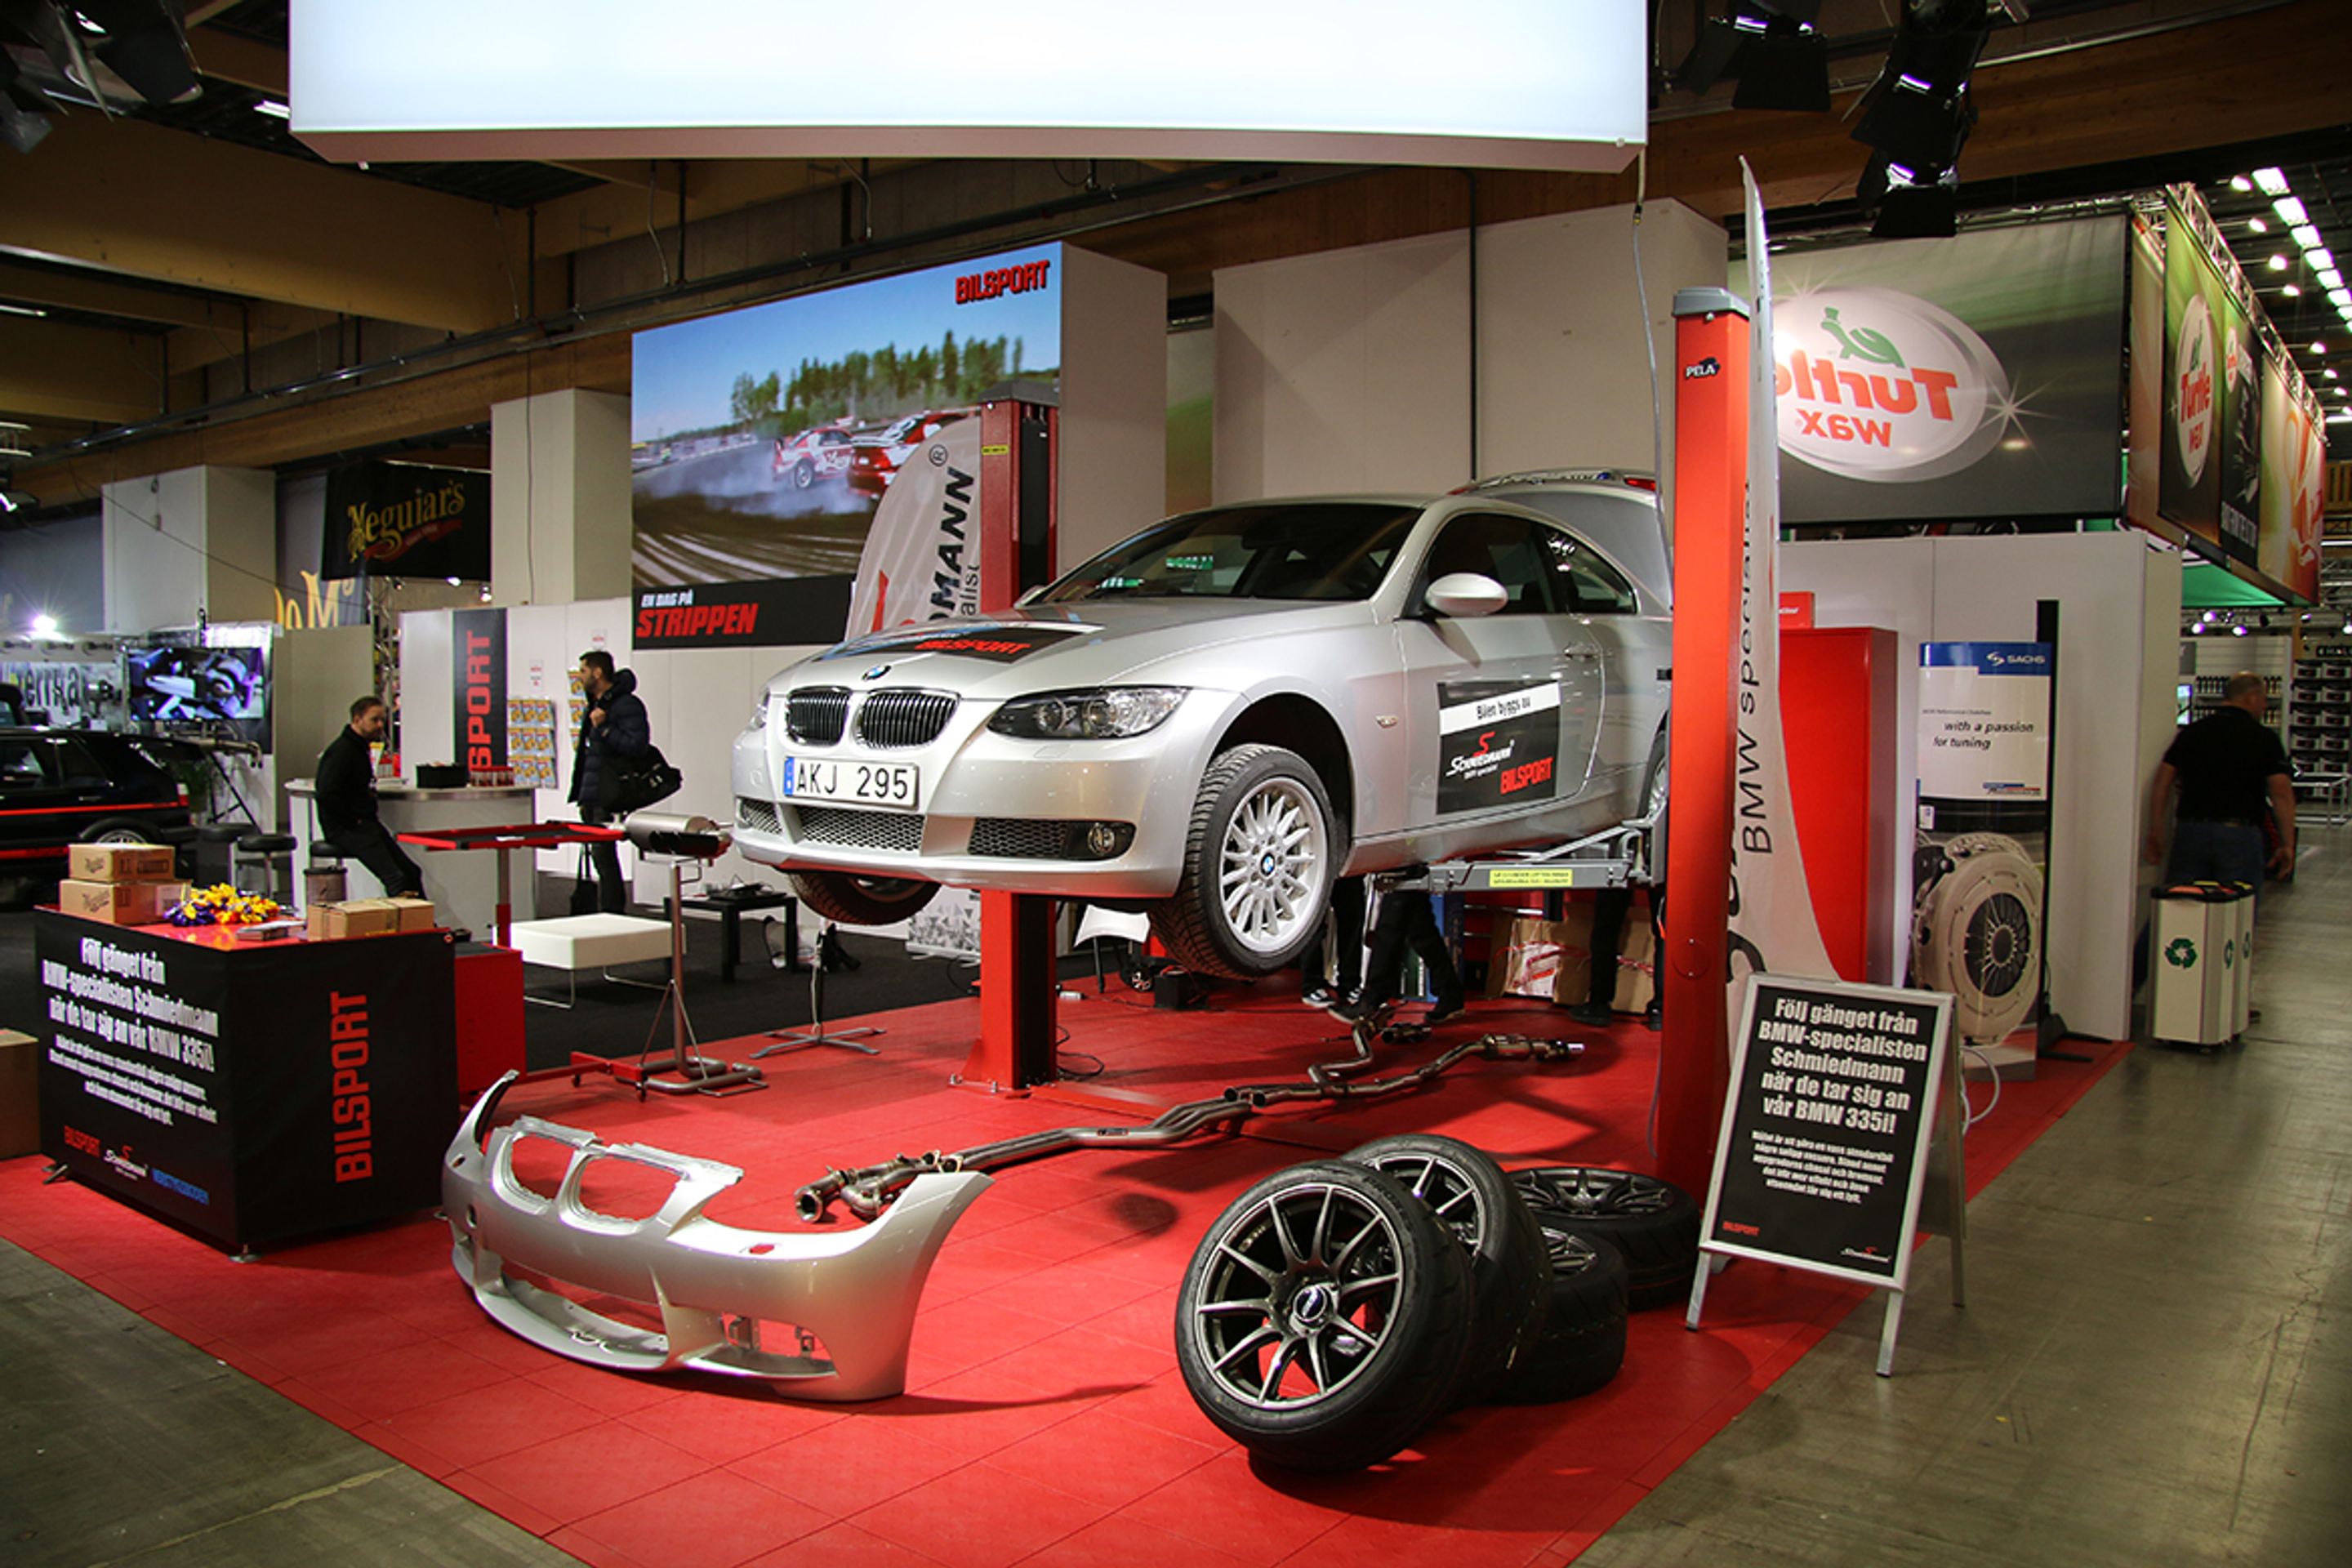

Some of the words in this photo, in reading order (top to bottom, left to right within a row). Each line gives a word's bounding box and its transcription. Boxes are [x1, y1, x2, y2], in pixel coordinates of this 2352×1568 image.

[955, 260, 1050, 303] BILSPORT
[1686, 364, 1716, 377] PELA
[635, 603, 760, 638] STRIPPEN
[2007, 655, 2045, 665] SACHS
[1933, 737, 1948, 746] for
[1950, 737, 1991, 750] tuning
[1944, 720, 1971, 733] with
[1984, 721, 2034, 734] passion
[796, 763, 838, 795] AKJ
[856, 766, 908, 799] 295
[1499, 757, 1553, 795] BILSPORT
[1737, 730, 1773, 855] BMW
[1775, 998, 1810, 1021] Följ
[1811, 1004, 1875, 1030] gänget
[1878, 1011, 1918, 1035] från
[1758, 1022, 1928, 1062] BMW-specialisten
[1771, 1047, 1905, 1084] Schmiedmann
[330, 991, 373, 1183] BILSPORT
[1762, 1071, 1793, 1092] när
[1795, 1076, 1820, 1097] de
[1822, 1081, 1850, 1101] tar
[1851, 1085, 1882, 1107] sig
[1885, 1091, 1910, 1111] an
[1763, 1094, 1793, 1117] vår
[1795, 1099, 1844, 1125] BMW
[1845, 1108, 1897, 1134] 335i!
